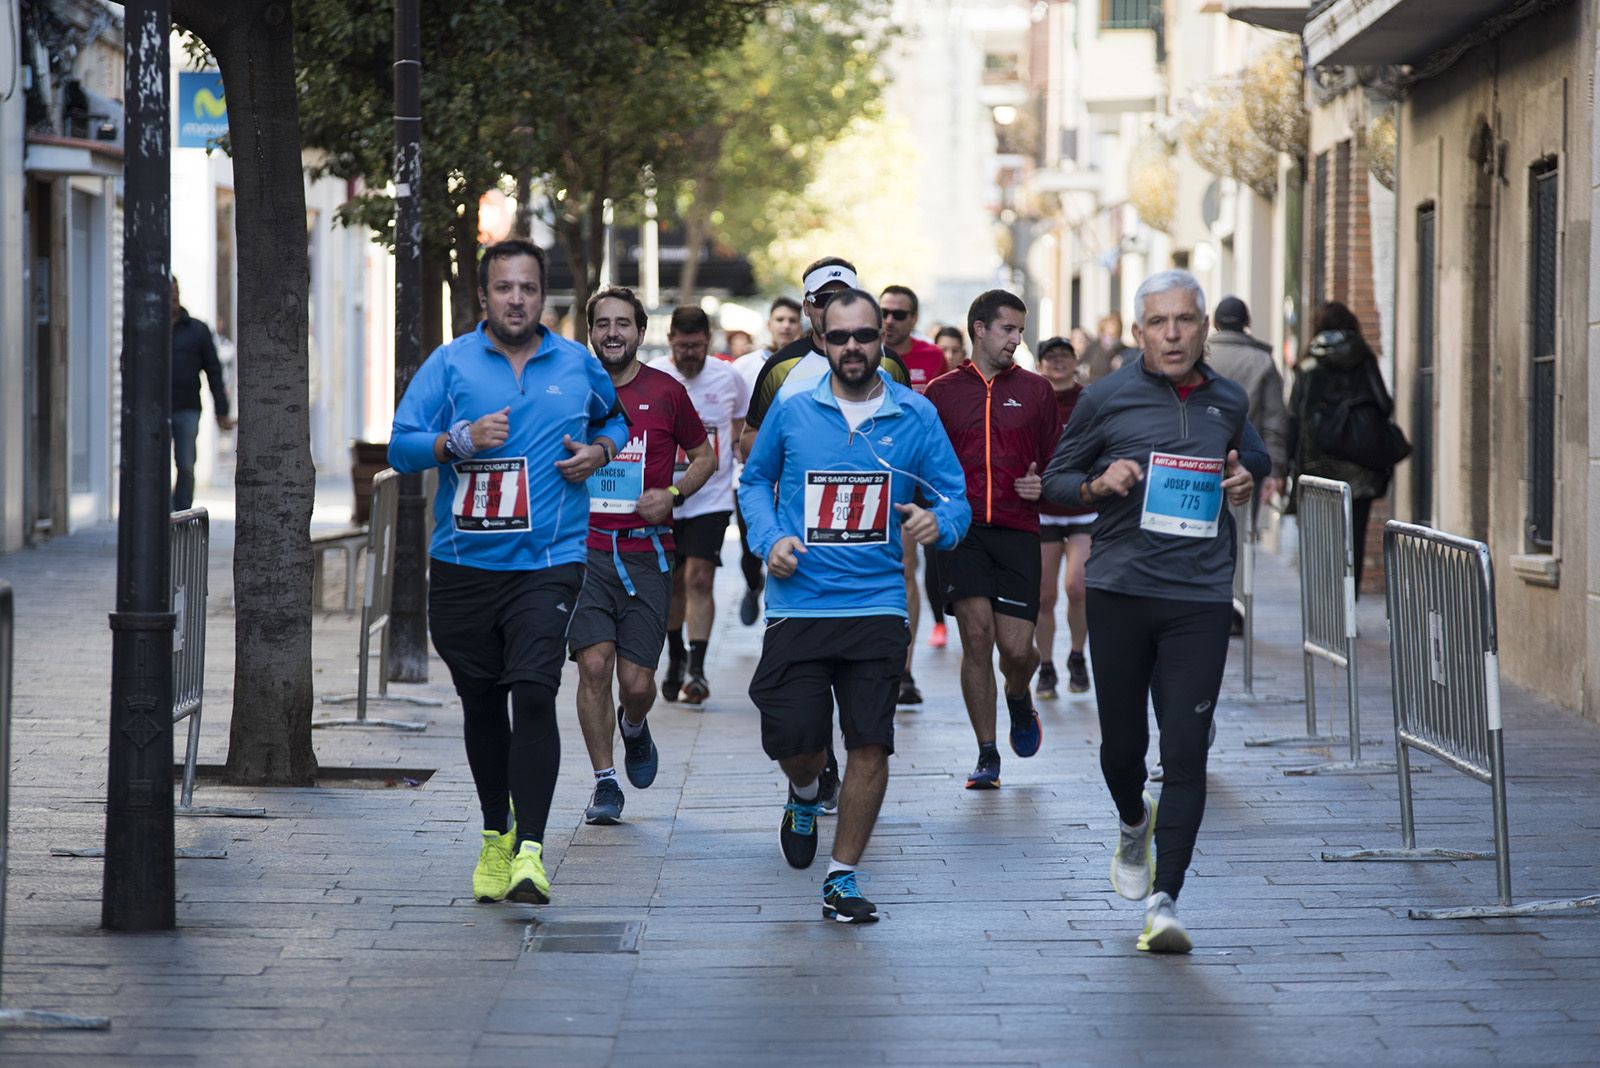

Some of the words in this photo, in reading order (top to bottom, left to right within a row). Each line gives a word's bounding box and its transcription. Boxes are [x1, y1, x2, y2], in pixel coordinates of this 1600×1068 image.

[483, 463, 509, 471] CUGAT
[1155, 457, 1177, 466] MITJA
[1179, 460, 1198, 468] SANT
[601, 480, 616, 492] 901
[1164, 477, 1190, 491] JOSEP
[1192, 481, 1216, 493] MARIA
[1180, 494, 1200, 511] 775
